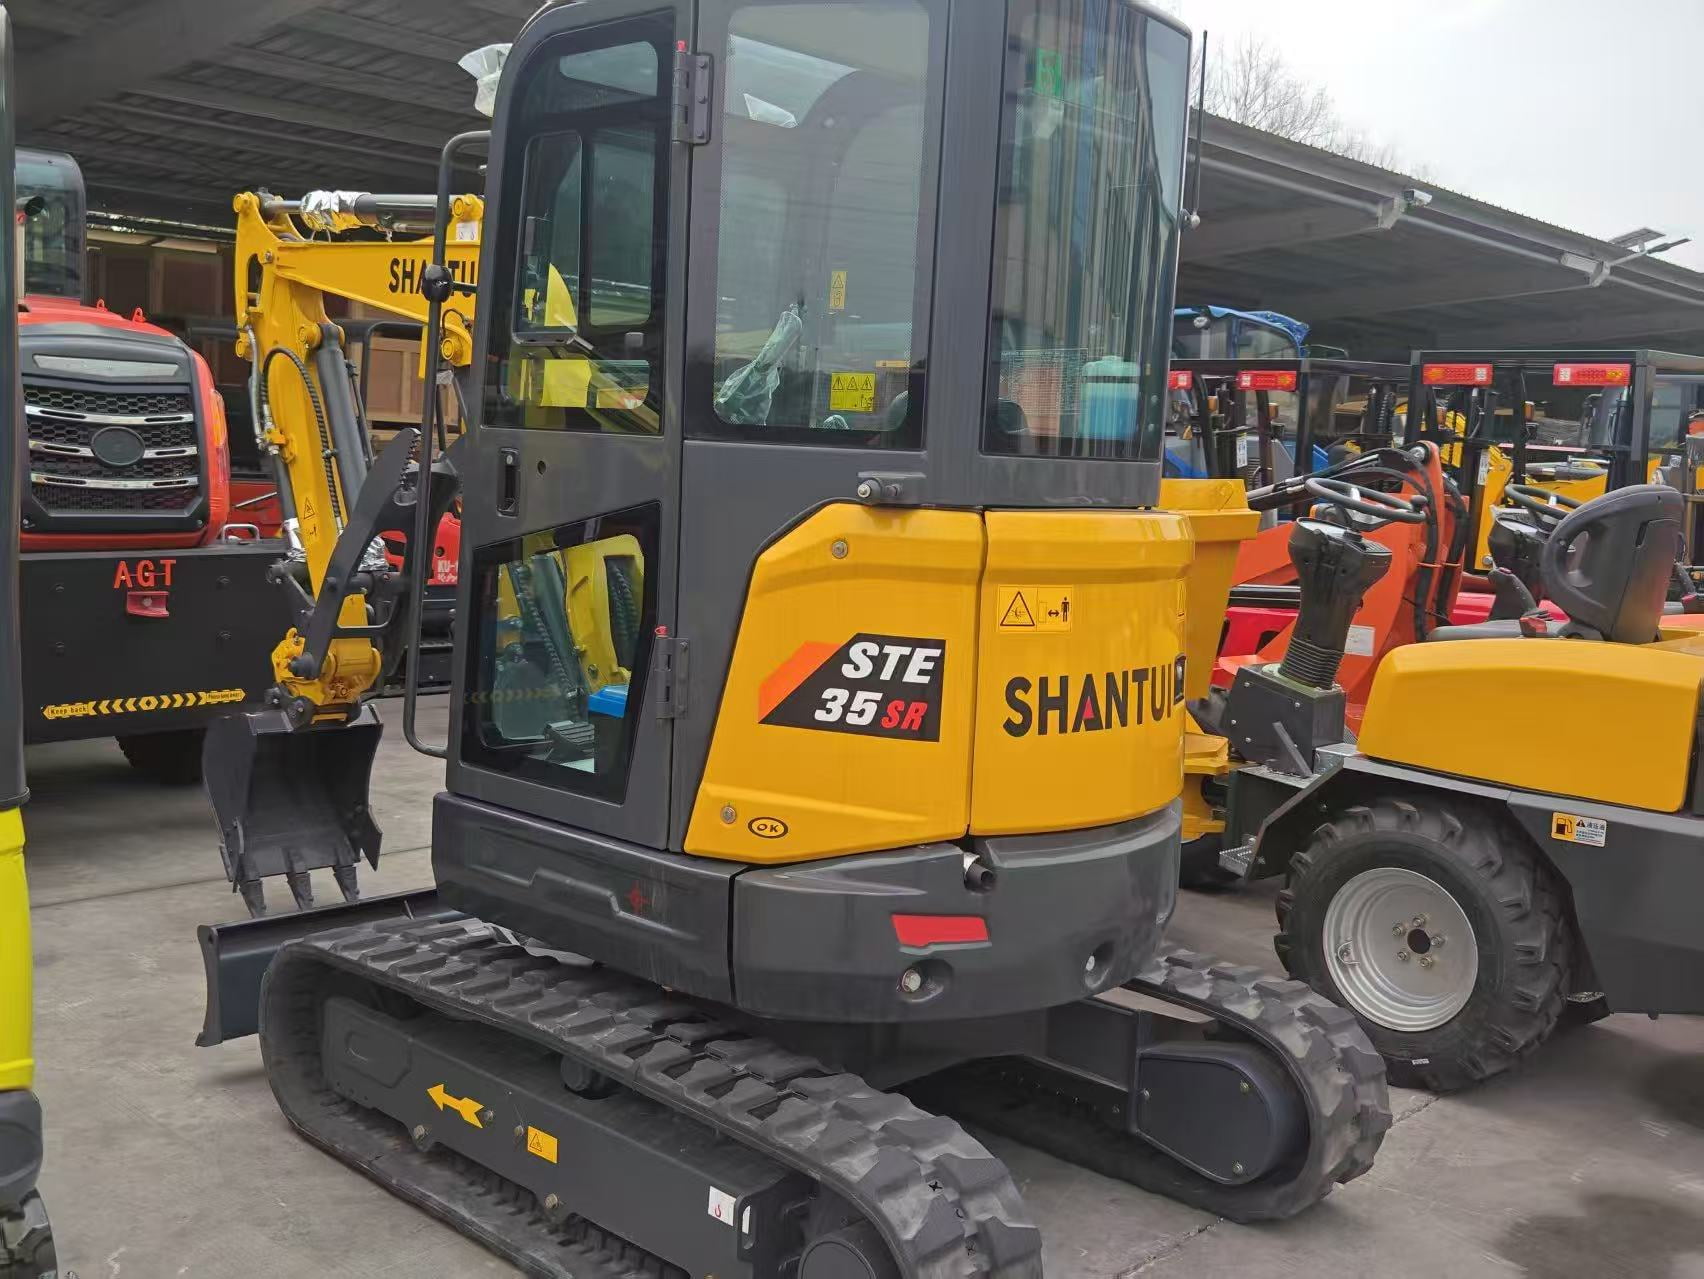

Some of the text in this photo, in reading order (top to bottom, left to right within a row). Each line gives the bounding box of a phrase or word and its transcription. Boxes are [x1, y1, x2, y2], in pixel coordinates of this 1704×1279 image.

[113, 559, 177, 589] AGT
[841, 641, 942, 684] STE
[50, 705, 87, 715] Keep back
[814, 687, 928, 731] 35 SR
[1002, 663, 1172, 738] SHANTUI
[757, 823, 779, 833] OK
